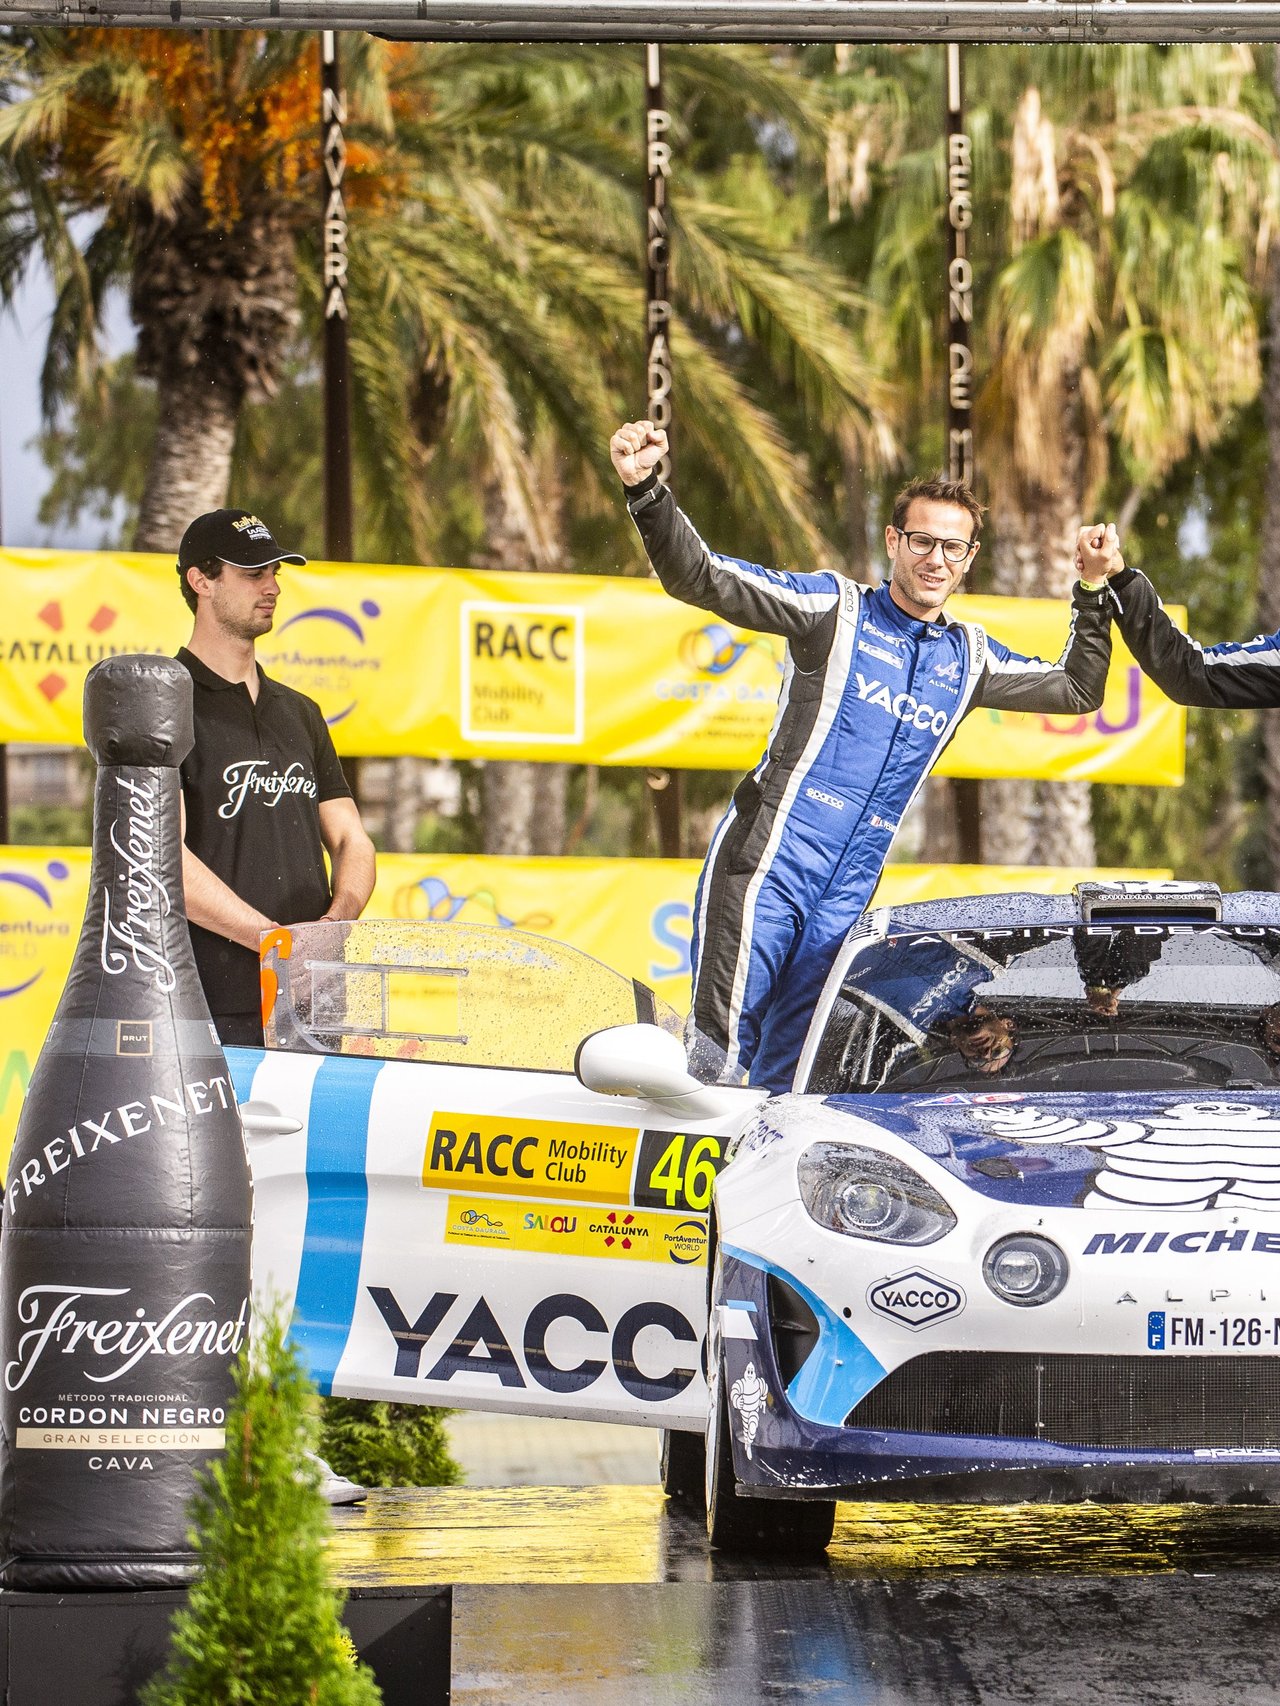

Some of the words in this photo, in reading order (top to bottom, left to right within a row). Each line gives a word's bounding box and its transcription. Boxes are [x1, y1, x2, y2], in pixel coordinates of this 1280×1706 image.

[323, 88, 347, 320] NAVARRA
[948, 133, 974, 324] REGION
[647, 109, 673, 431] PRINCIPADO
[948, 342, 974, 410] DE
[473, 621, 569, 663] RACC
[473, 683, 546, 707] Mobility
[928, 678, 960, 695] ALPINE
[472, 705, 511, 724] Club
[855, 672, 948, 737] YACCO
[100, 776, 177, 992] Freixenet
[909, 925, 1113, 947] ALPINE
[121, 1034, 149, 1043] BRUT
[7, 1076, 229, 1216] FREIXENET
[429, 1128, 539, 1179] RACC
[547, 1138, 628, 1168] Mobility
[545, 1161, 587, 1183] Club
[648, 1134, 721, 1211] 46
[523, 1212, 577, 1234] SALOU
[588, 1224, 649, 1237] CATALUNYA
[664, 1233, 708, 1244] PortAventur
[674, 1242, 700, 1252] WORLD
[881, 1290, 950, 1308] YACCO
[3, 1284, 248, 1391] Freixenet
[366, 1285, 708, 1402] YACC
[1151, 1334, 1161, 1347] F
[58, 1391, 105, 1402] MÉTODO
[110, 1394, 189, 1403] TRADICIONAL
[19, 1406, 129, 1425] CORDON
[142, 1406, 226, 1425] NEGRO
[42, 1433, 91, 1445] GRAN
[97, 1430, 201, 1445] SELECCIÓN
[88, 1456, 155, 1471] CAVA
